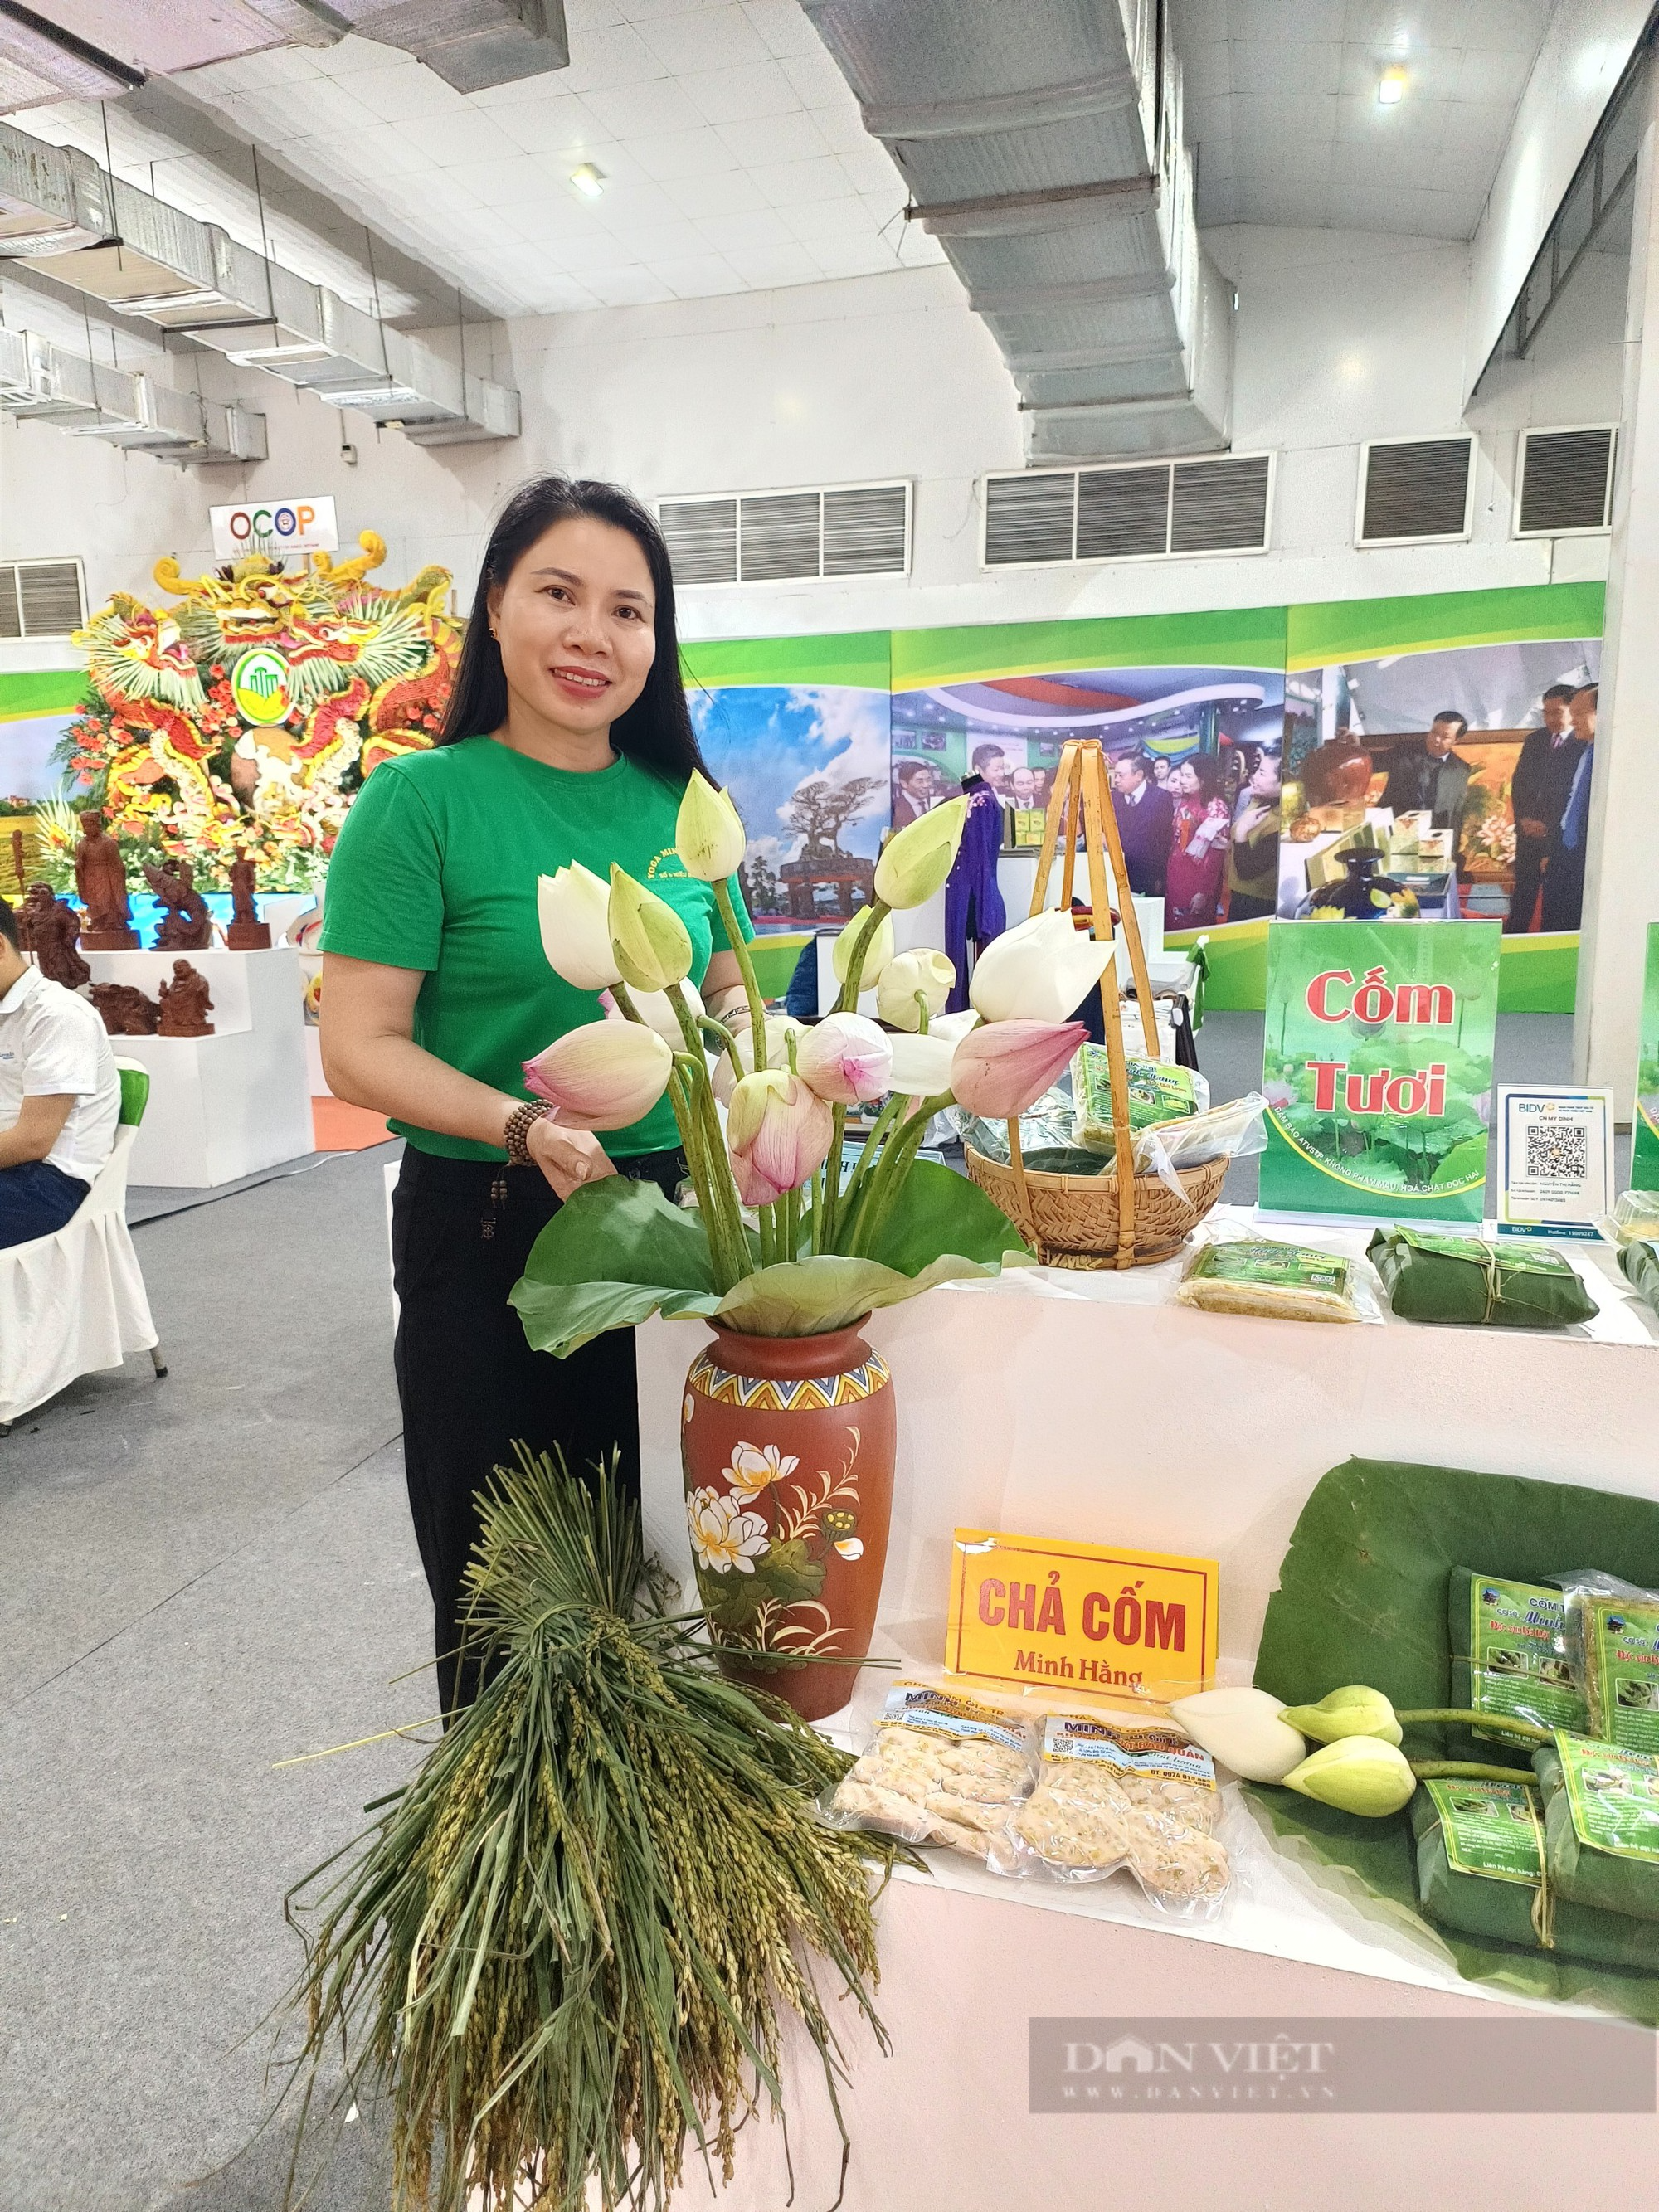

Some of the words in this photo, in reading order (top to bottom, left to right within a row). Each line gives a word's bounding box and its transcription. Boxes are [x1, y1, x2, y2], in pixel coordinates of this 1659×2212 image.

[230, 505, 315, 539] OCOP
[1306, 965, 1456, 1025] Cốm
[1305, 1060, 1447, 1117] Tươi
[1519, 1103, 1545, 1113] BIDV
[979, 1570, 1067, 1636] CHẢ
[1082, 1581, 1186, 1653] CỐM
[1529, 1597, 1559, 1611] CỐM
[1013, 1649, 1074, 1679] Minh
[1078, 1658, 1144, 1690] Hằng
[1483, 1861, 1497, 1869] Liên
[1506, 1866, 1517, 1874] đặt
